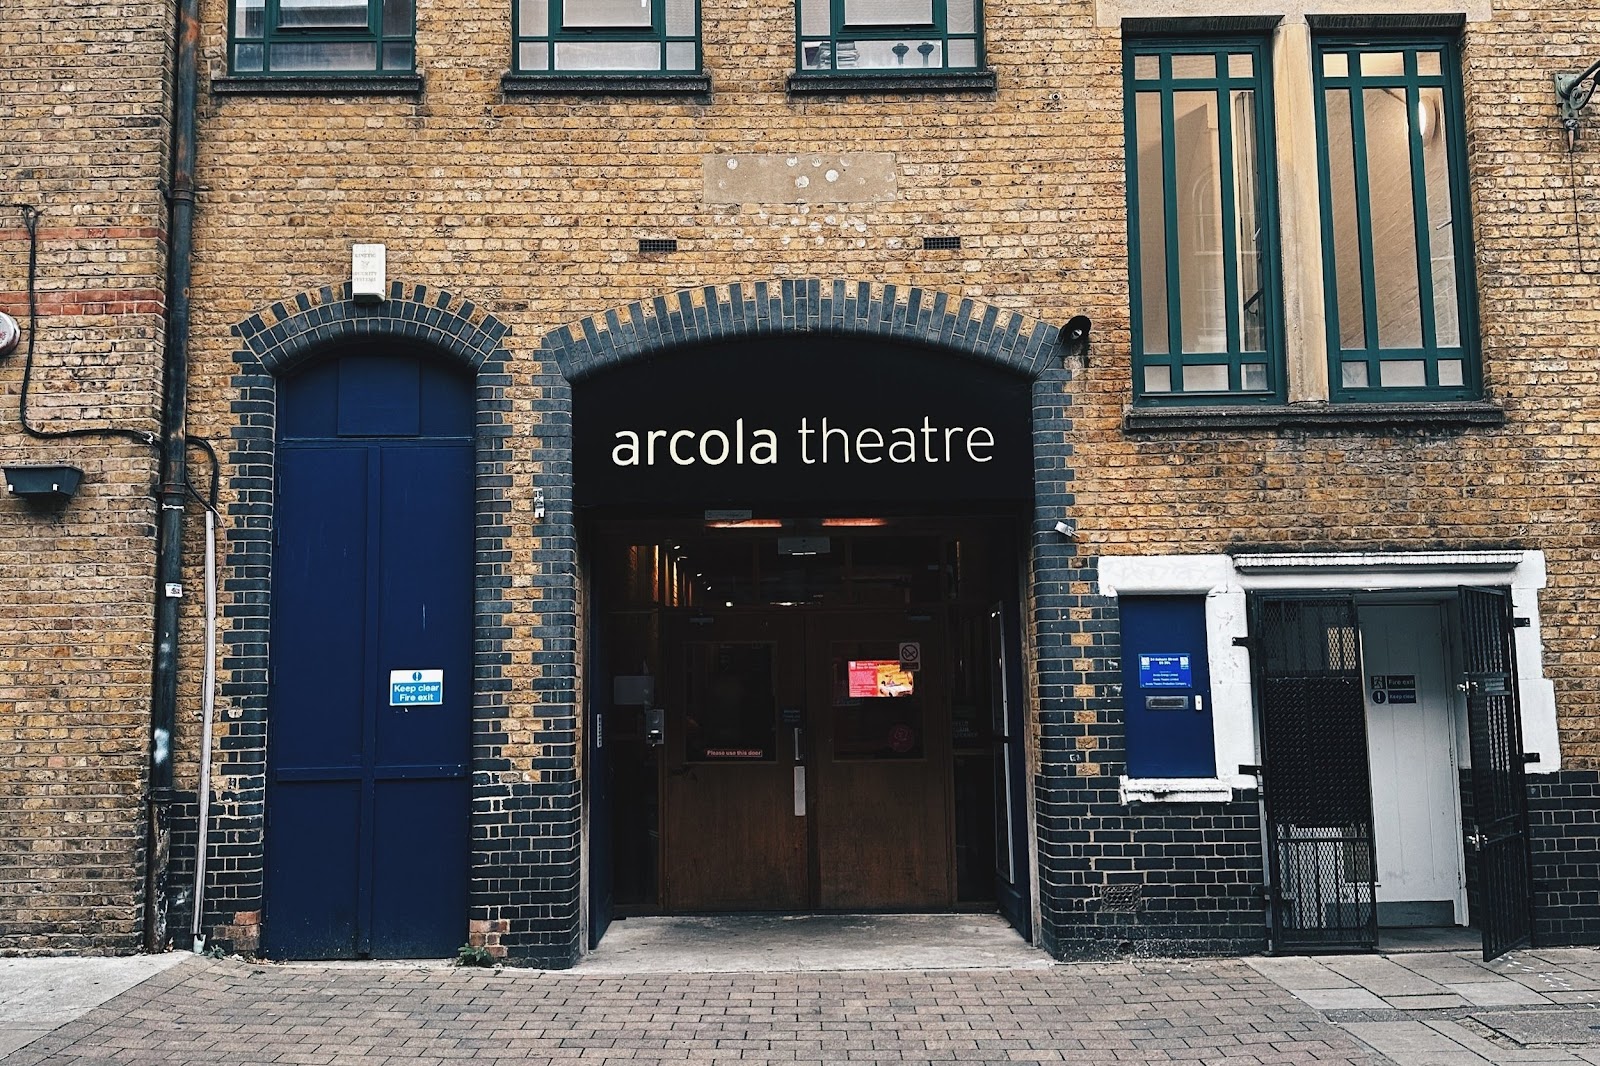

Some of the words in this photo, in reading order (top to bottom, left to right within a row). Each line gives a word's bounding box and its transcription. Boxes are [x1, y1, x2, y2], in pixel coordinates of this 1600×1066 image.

[611, 417, 778, 466] arcola
[798, 415, 995, 464] theatre
[394, 684, 417, 693] Keep
[418, 684, 440, 692] clear
[417, 693, 434, 701] exit
